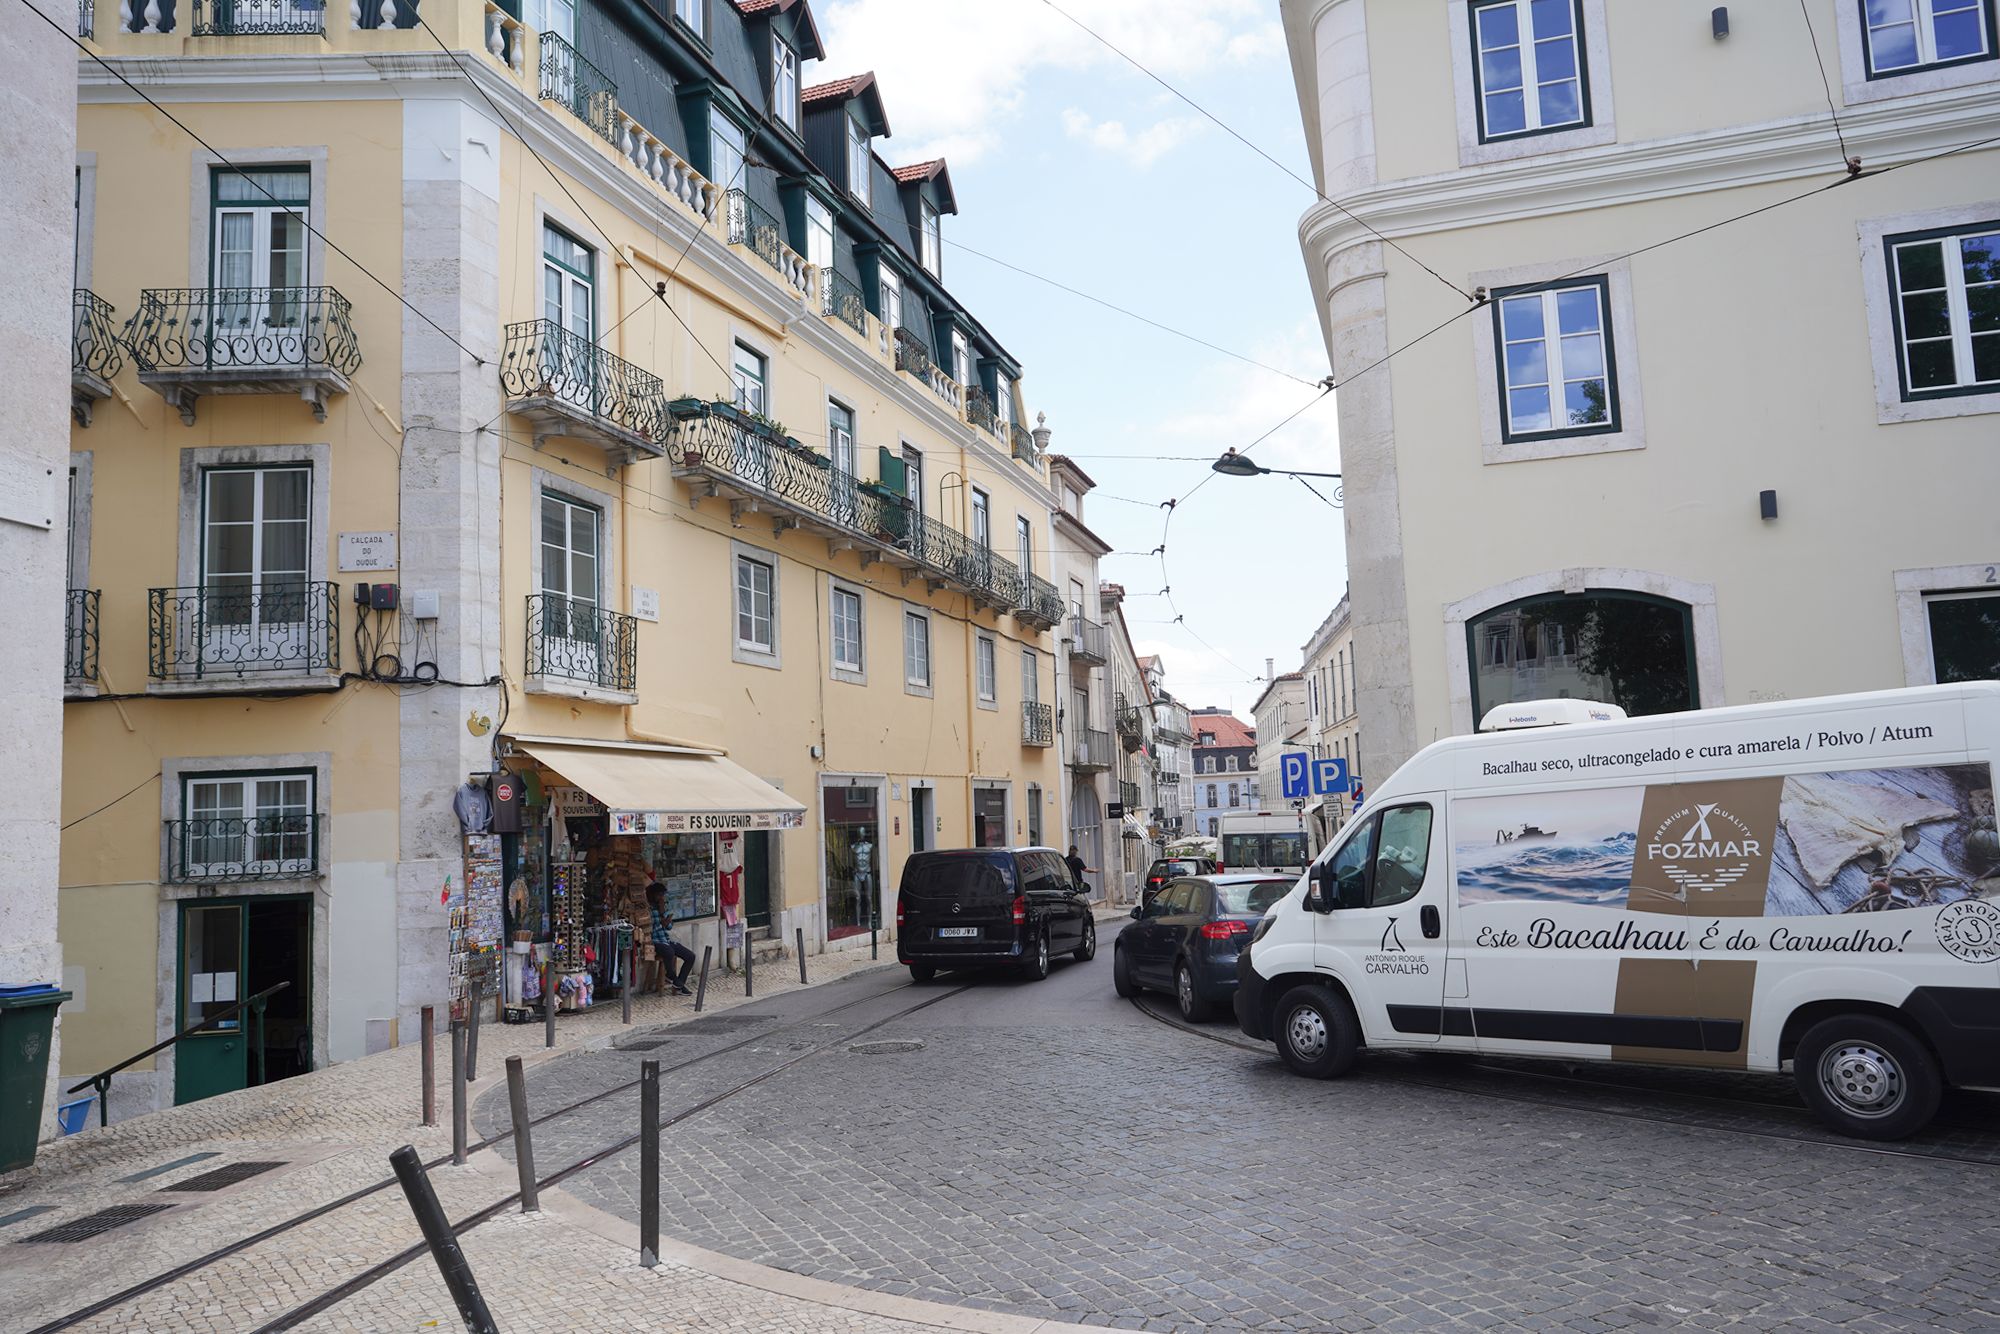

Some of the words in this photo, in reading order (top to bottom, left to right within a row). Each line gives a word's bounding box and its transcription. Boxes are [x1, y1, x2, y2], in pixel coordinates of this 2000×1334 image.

[1985, 566, 1997, 582] 2
[1482, 760, 1538, 776] Bacalhau
[1541, 759, 1574, 772] seco,
[1578, 747, 1681, 768] ultracongelado
[1685, 748, 1695, 759] e
[1699, 744, 1733, 758] cura
[1737, 735, 1801, 755] amarela
[1817, 729, 1864, 748] Polvo
[1881, 725, 1934, 742] Atum
[1286, 757, 1303, 794] P
[1320, 762, 1340, 791] P
[572, 791, 584, 802] FS
[690, 815, 702, 829] FS
[705, 815, 752, 829] SOUVENIR
[1654, 808, 1690, 841] PREMIUM
[1713, 807, 1752, 838] QUALITY
[1647, 840, 1761, 860] FOZMAR
[1476, 926, 1520, 948] Este
[1527, 918, 1690, 951] Bacalhau
[1699, 920, 1720, 950] É
[1725, 929, 1760, 951] do
[1769, 927, 1913, 952] Carvalho!
[1941, 917, 1996, 960] NATURAL
[1365, 963, 1429, 975] CARVALHO
[1398, 955, 1426, 963] ROQUE
